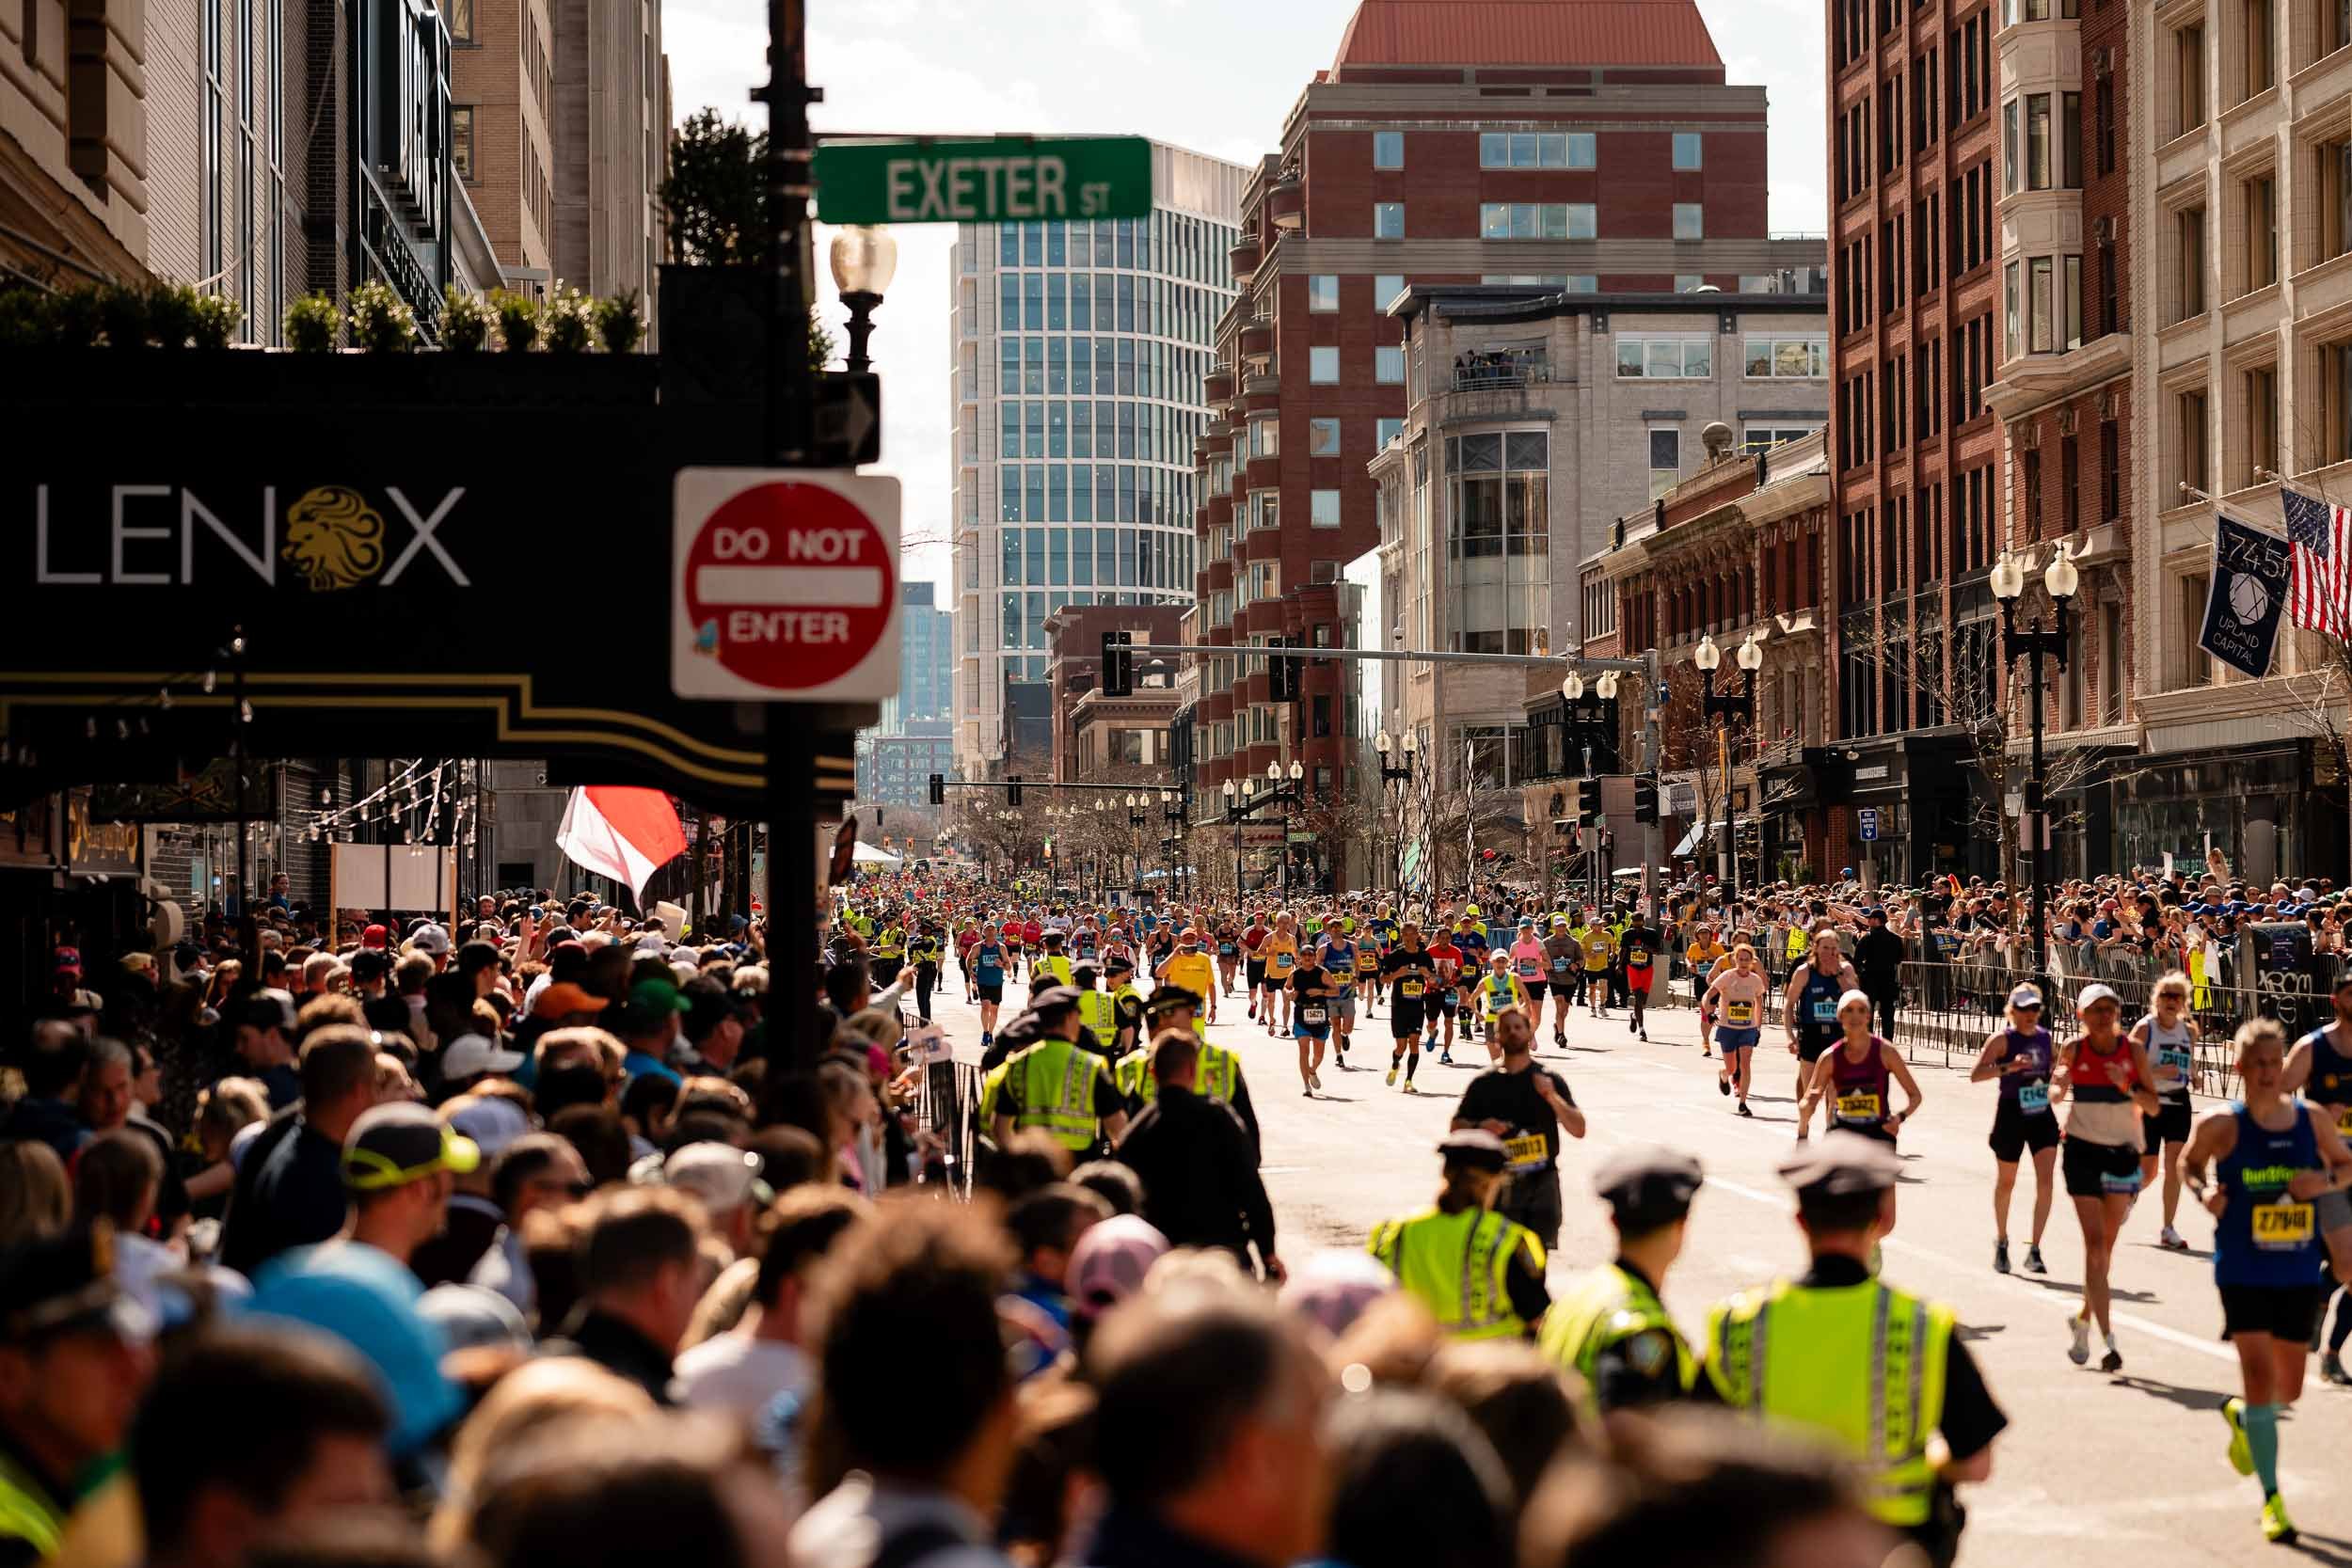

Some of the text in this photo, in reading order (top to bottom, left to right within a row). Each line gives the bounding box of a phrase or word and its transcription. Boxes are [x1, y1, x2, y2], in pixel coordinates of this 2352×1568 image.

[886, 155, 1112, 219] EXETER ST
[713, 527, 867, 562] DO NOT
[728, 610, 850, 643] ENTER
[2213, 632, 2255, 667] CAPITAL
